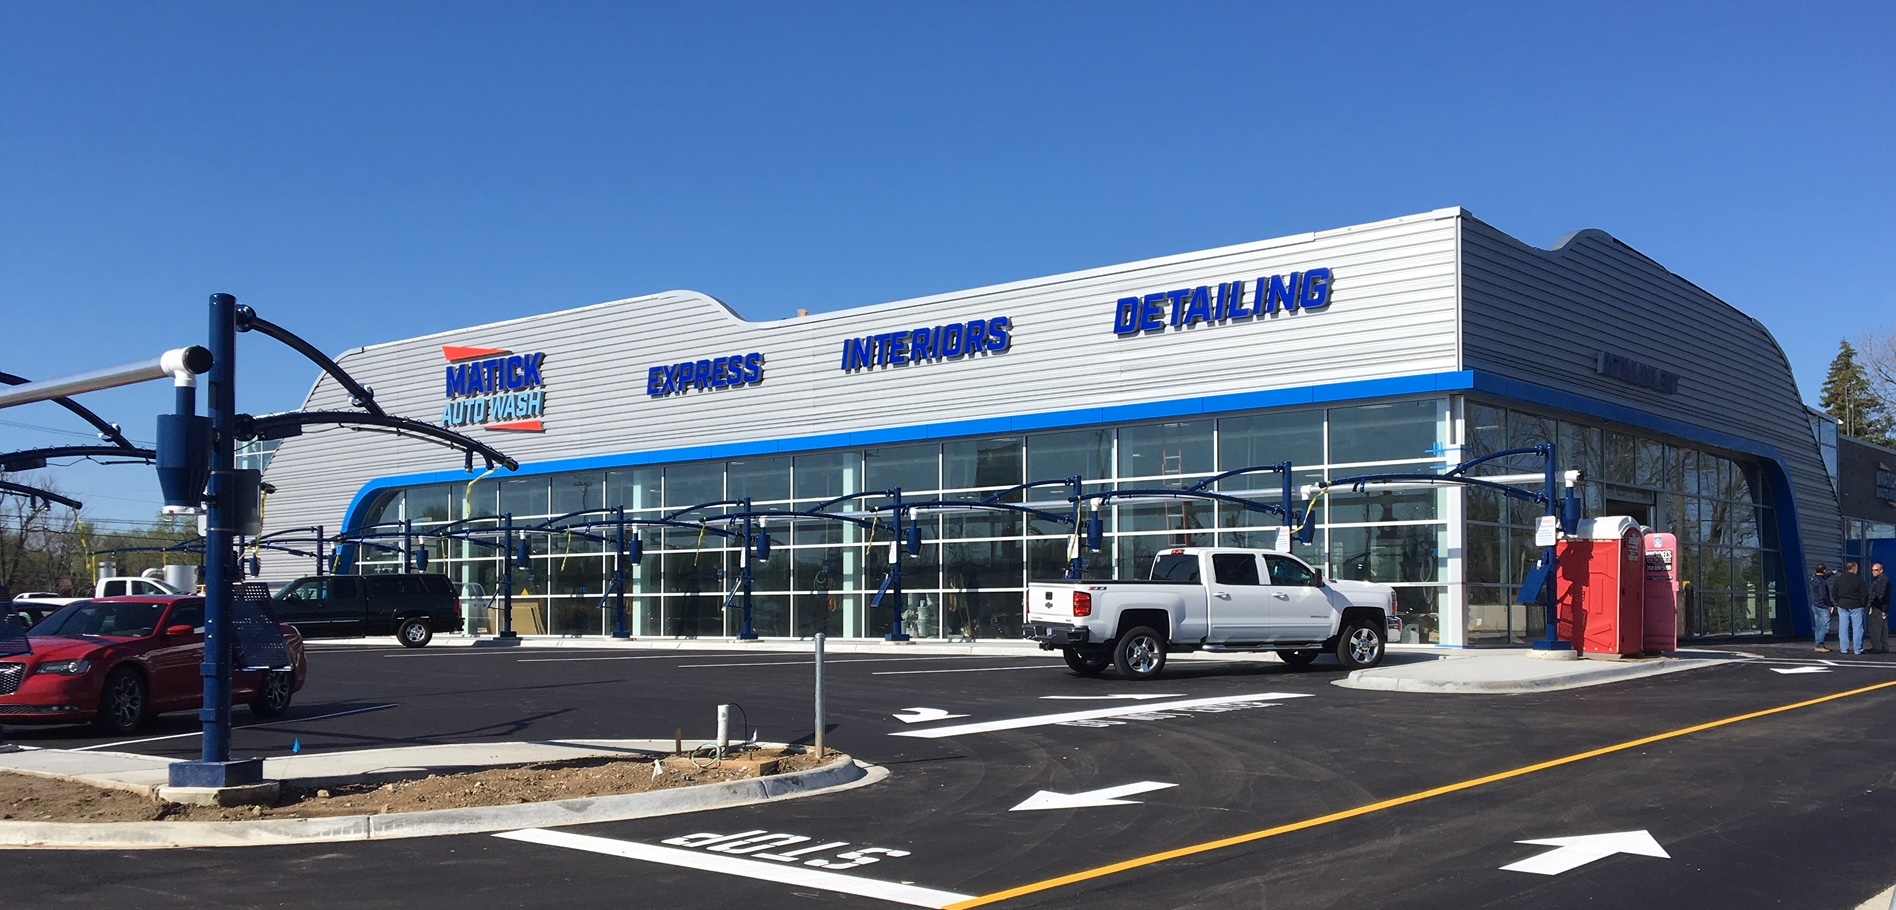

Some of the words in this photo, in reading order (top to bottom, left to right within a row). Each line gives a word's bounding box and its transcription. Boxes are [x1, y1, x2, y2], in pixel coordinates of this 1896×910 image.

[1113, 267, 1333, 338] DETAILING
[841, 316, 1011, 374] INTERIORS
[446, 352, 545, 398] MATICK
[647, 352, 764, 398] EXPRESS
[441, 399, 488, 427] AUTO
[490, 391, 545, 421] WASH
[661, 829, 912, 870] STOP
